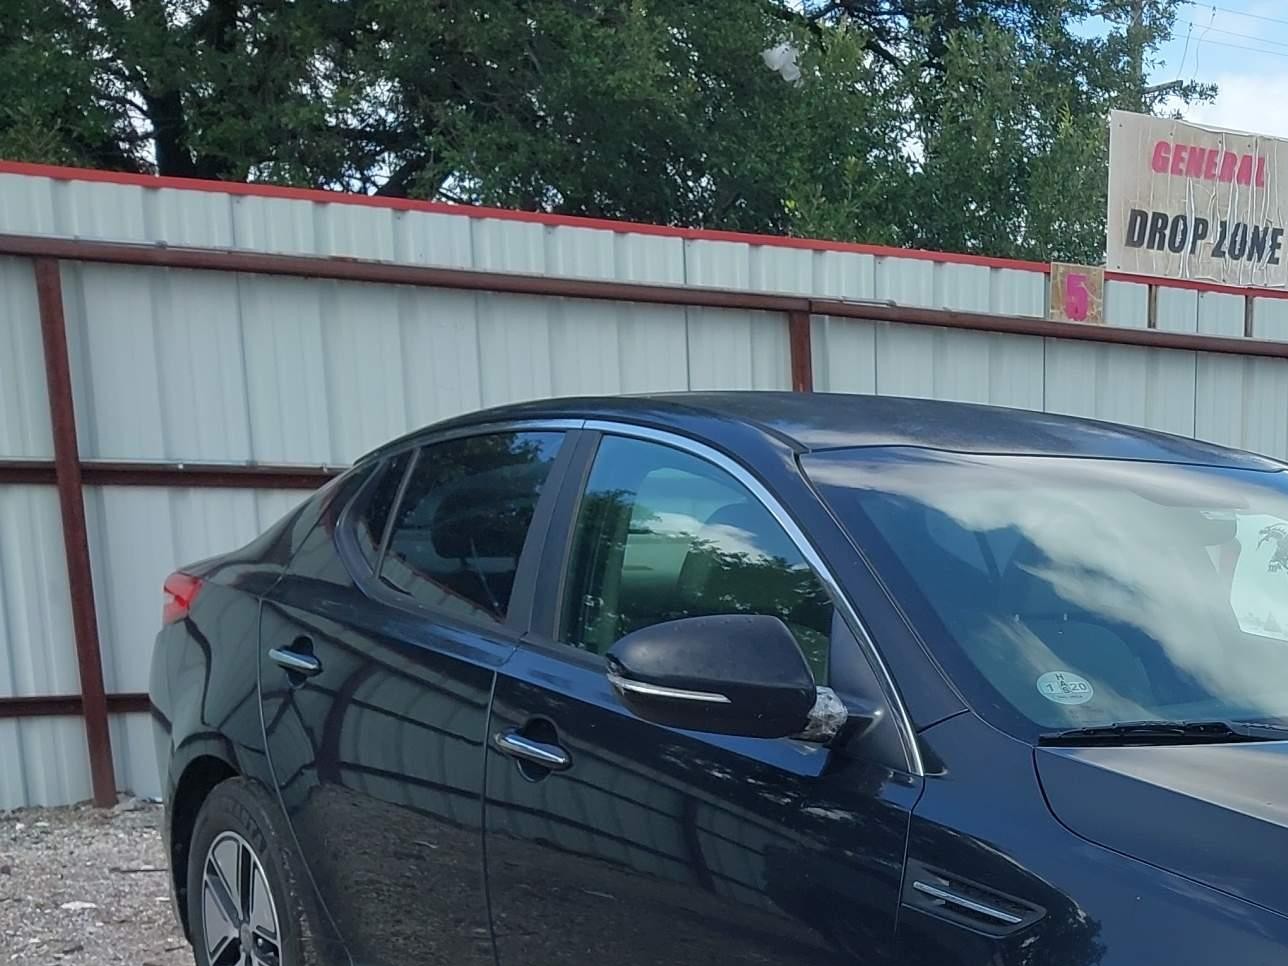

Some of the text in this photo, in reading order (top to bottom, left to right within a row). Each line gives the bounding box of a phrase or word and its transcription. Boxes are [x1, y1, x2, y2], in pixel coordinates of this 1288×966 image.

[1151, 140, 1266, 188] GENERAL
[1124, 208, 1209, 256] DROP
[1211, 219, 1284, 265] ZONE
[1064, 273, 1089, 321] 5
